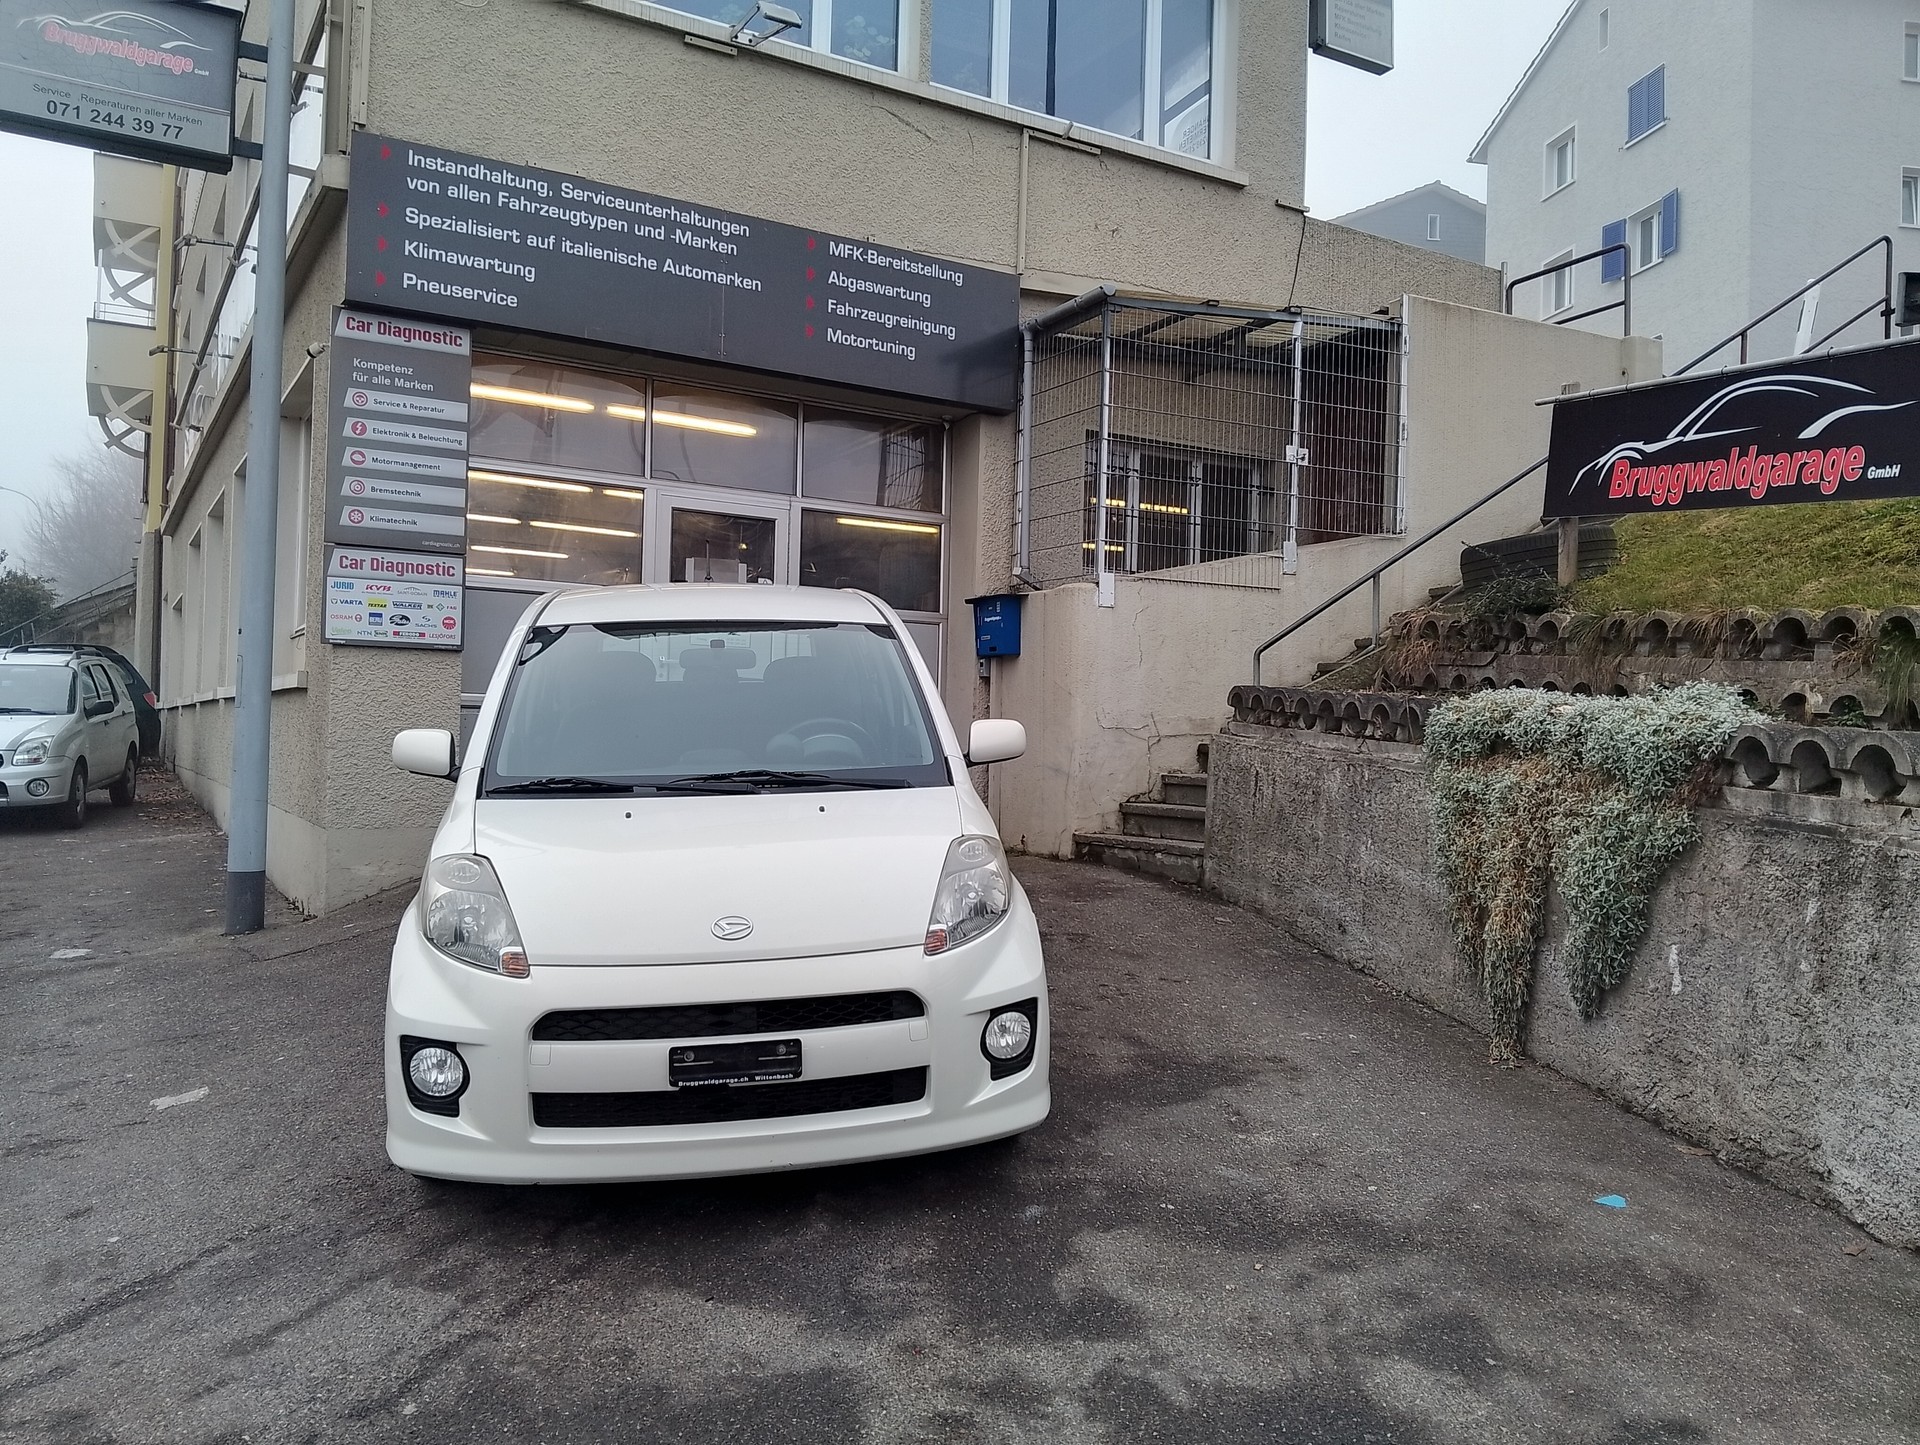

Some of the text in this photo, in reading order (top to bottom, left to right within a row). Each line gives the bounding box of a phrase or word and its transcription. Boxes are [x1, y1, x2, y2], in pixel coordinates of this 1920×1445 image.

[44, 22, 194, 75] Bruggwaldgarage
[32, 82, 71, 99] Service
[144, 108, 165, 118] aller
[167, 111, 203, 126] Marken
[46, 100, 184, 140] 071 244 39 77
[407, 149, 751, 239] Instandhaltung, Serviceunterhaltungen
[406, 174, 738, 257] von allen Fahrzeugtypen und -Marken
[403, 240, 536, 283] Klimawartung
[404, 207, 762, 292] Spezialisiert auf italienische Automarken
[829, 240, 964, 287] MFK-Bereitstellung
[402, 272, 518, 308] Pneuservice
[827, 269, 932, 309] Abgaswartung
[346, 316, 463, 347] Car Diagnostic
[827, 298, 957, 341] Fahrzeugreinigung
[826, 327, 916, 361] Motortuning
[352, 371, 434, 392] für alle Marken
[353, 357, 414, 376] Kompetenz
[373, 398, 401, 409] Service
[409, 402, 445, 414] Reparatur
[372, 427, 463, 446] Elektronik & Beleuchtung
[371, 456, 441, 471] Motormanagement
[1608, 444, 1901, 506] Bruggwaldgarage GmbH
[370, 486, 422, 498] Bremstechnik
[369, 515, 418, 526] Klimatechnik
[339, 555, 456, 578] Car Diagnostic
[330, 580, 355, 591] JURID
[678, 1076, 749, 1087] Bruggwaldgarage.ch
